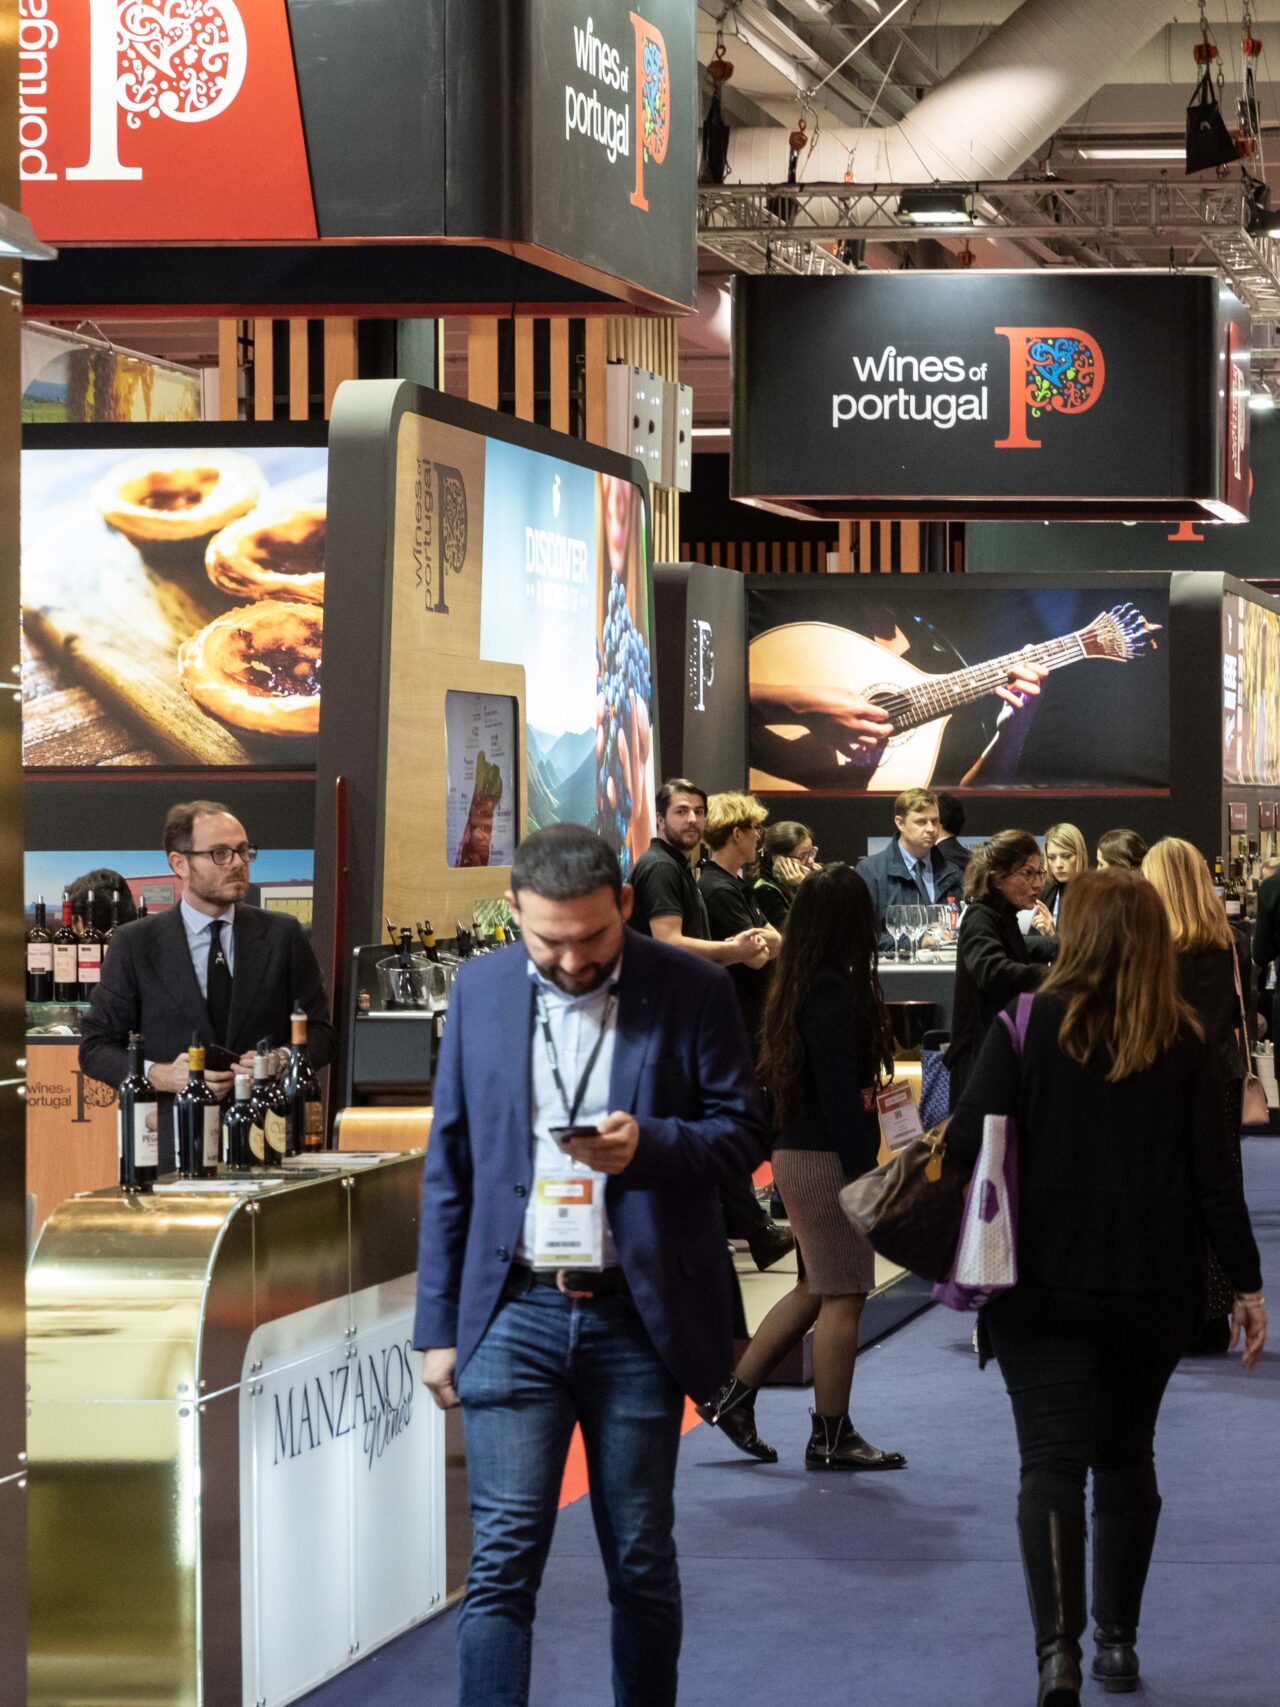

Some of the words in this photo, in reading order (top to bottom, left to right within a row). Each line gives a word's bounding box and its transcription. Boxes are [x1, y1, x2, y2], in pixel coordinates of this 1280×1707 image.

[19, 0, 58, 181] portuga
[573, 16, 620, 90] wines
[620, 66, 629, 93] of
[565, 85, 630, 164] portugal
[852, 346, 965, 382] wines
[969, 363, 988, 381] of
[832, 386, 988, 429] portugal
[413, 479, 423, 589] wines
[422, 458, 434, 613] portugal
[525, 526, 588, 584] DISCOVER
[26, 1095, 71, 1109] ortugal
[27, 1082, 64, 1093] wines
[273, 1339, 414, 1466] MANZANOS
